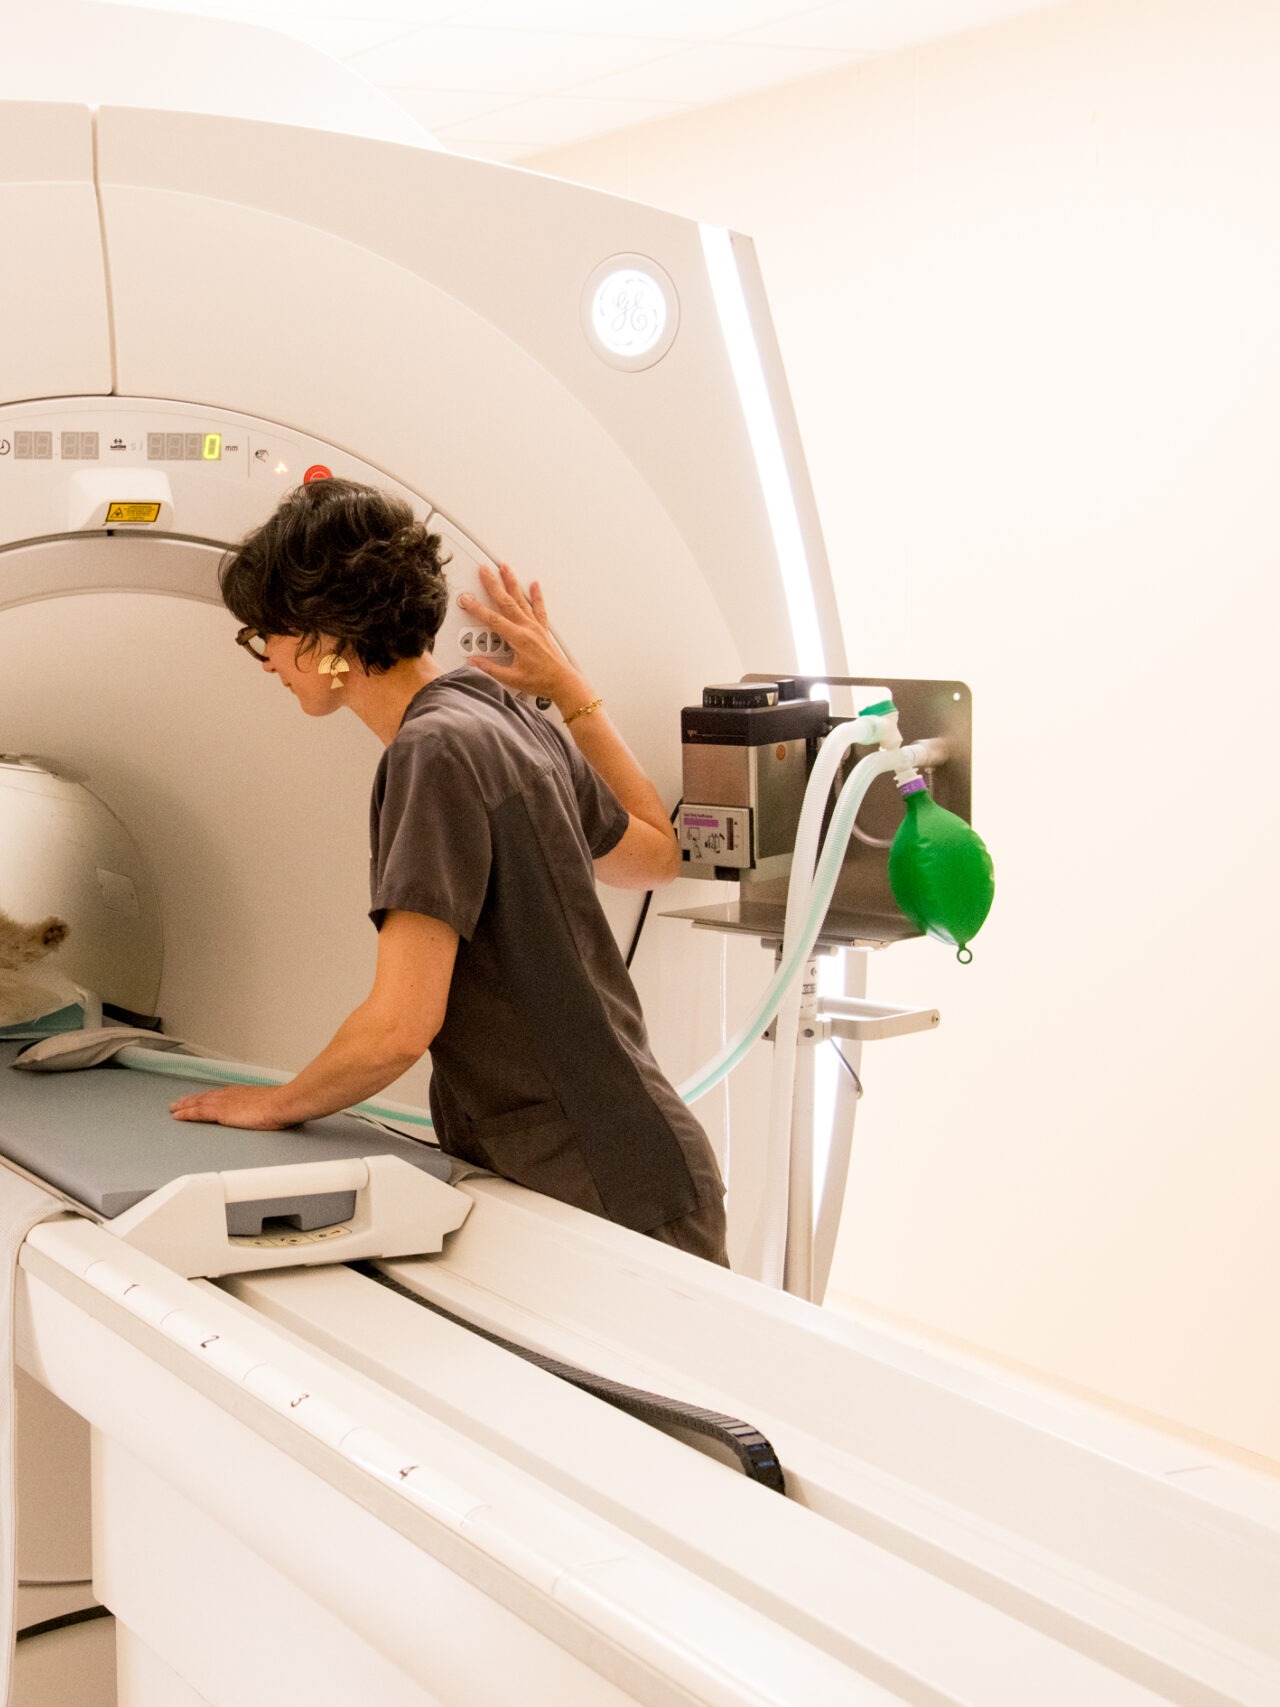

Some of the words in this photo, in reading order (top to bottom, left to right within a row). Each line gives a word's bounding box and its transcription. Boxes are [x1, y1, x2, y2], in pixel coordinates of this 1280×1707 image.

[203, 434, 220, 459] 0
[124, 1284, 140, 1295] 1
[200, 1334, 220, 1348] 2
[290, 1393, 310, 1408] 3
[399, 1464, 420, 1480] 4
